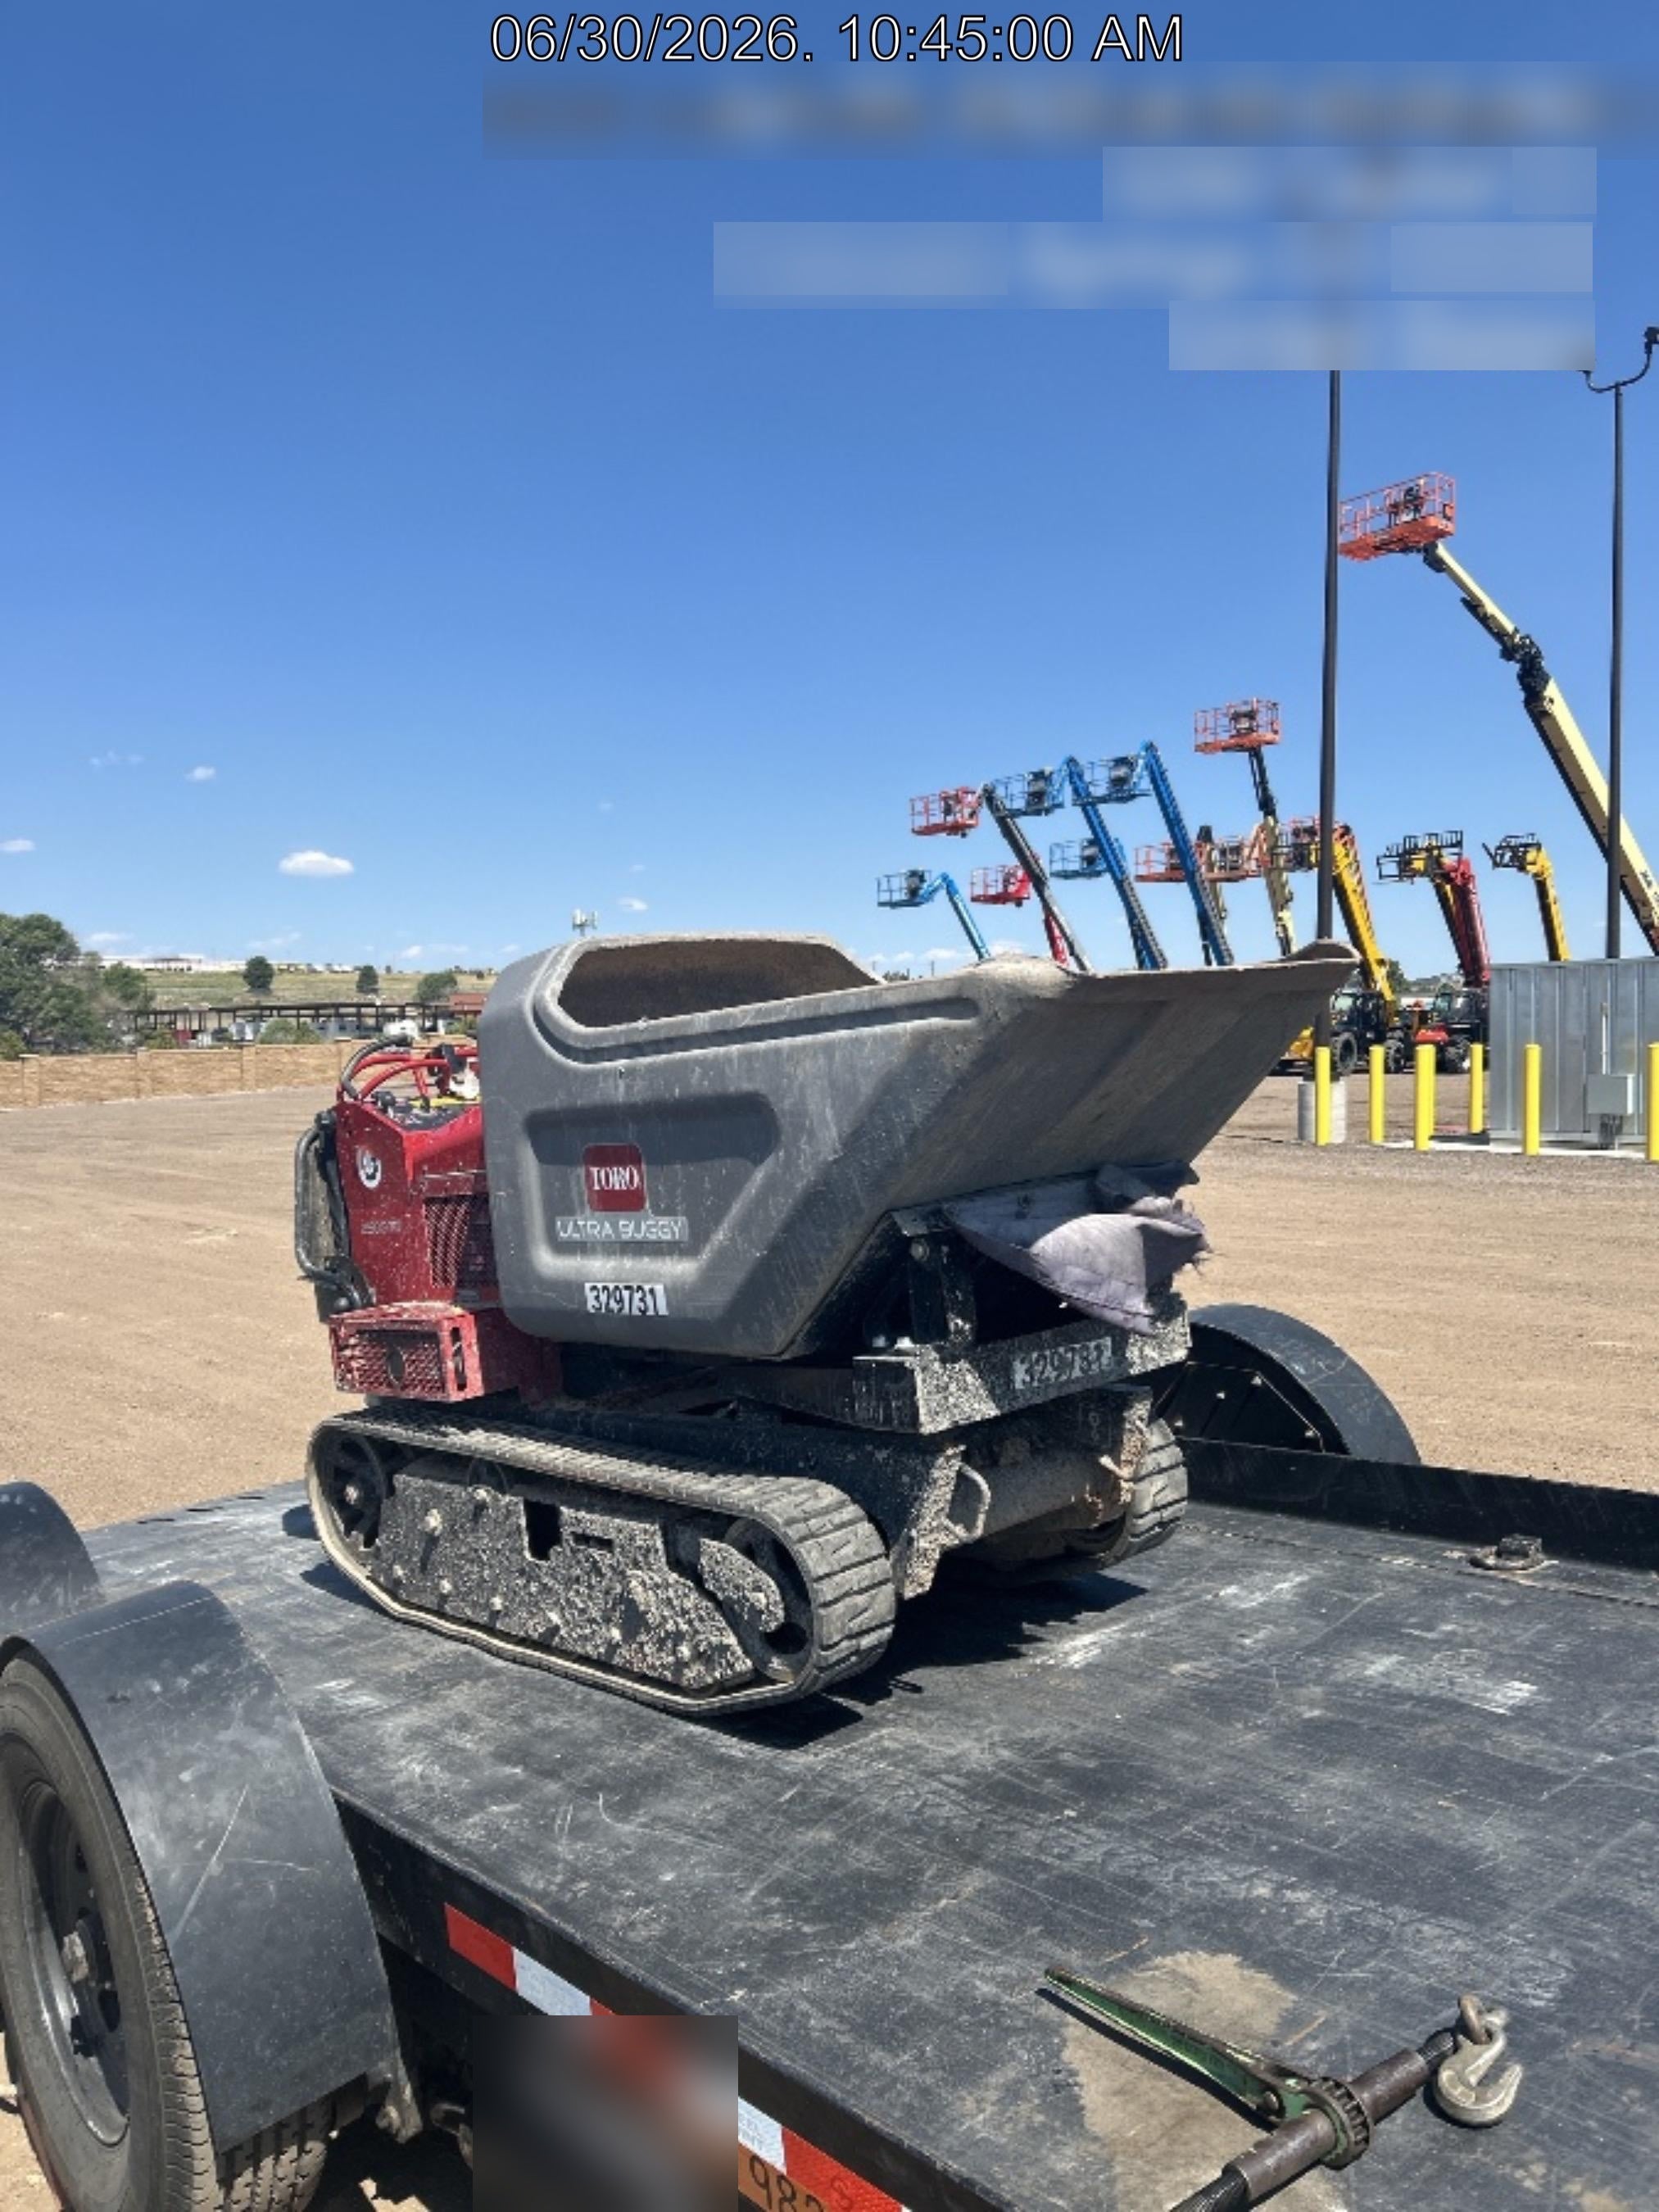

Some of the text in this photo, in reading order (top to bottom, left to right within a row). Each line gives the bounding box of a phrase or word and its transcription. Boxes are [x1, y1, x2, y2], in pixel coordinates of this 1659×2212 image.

[589, 1167, 639, 1190] TORO
[557, 1220, 682, 1240] ULTRA BUGGY
[589, 1285, 660, 1314] 329731
